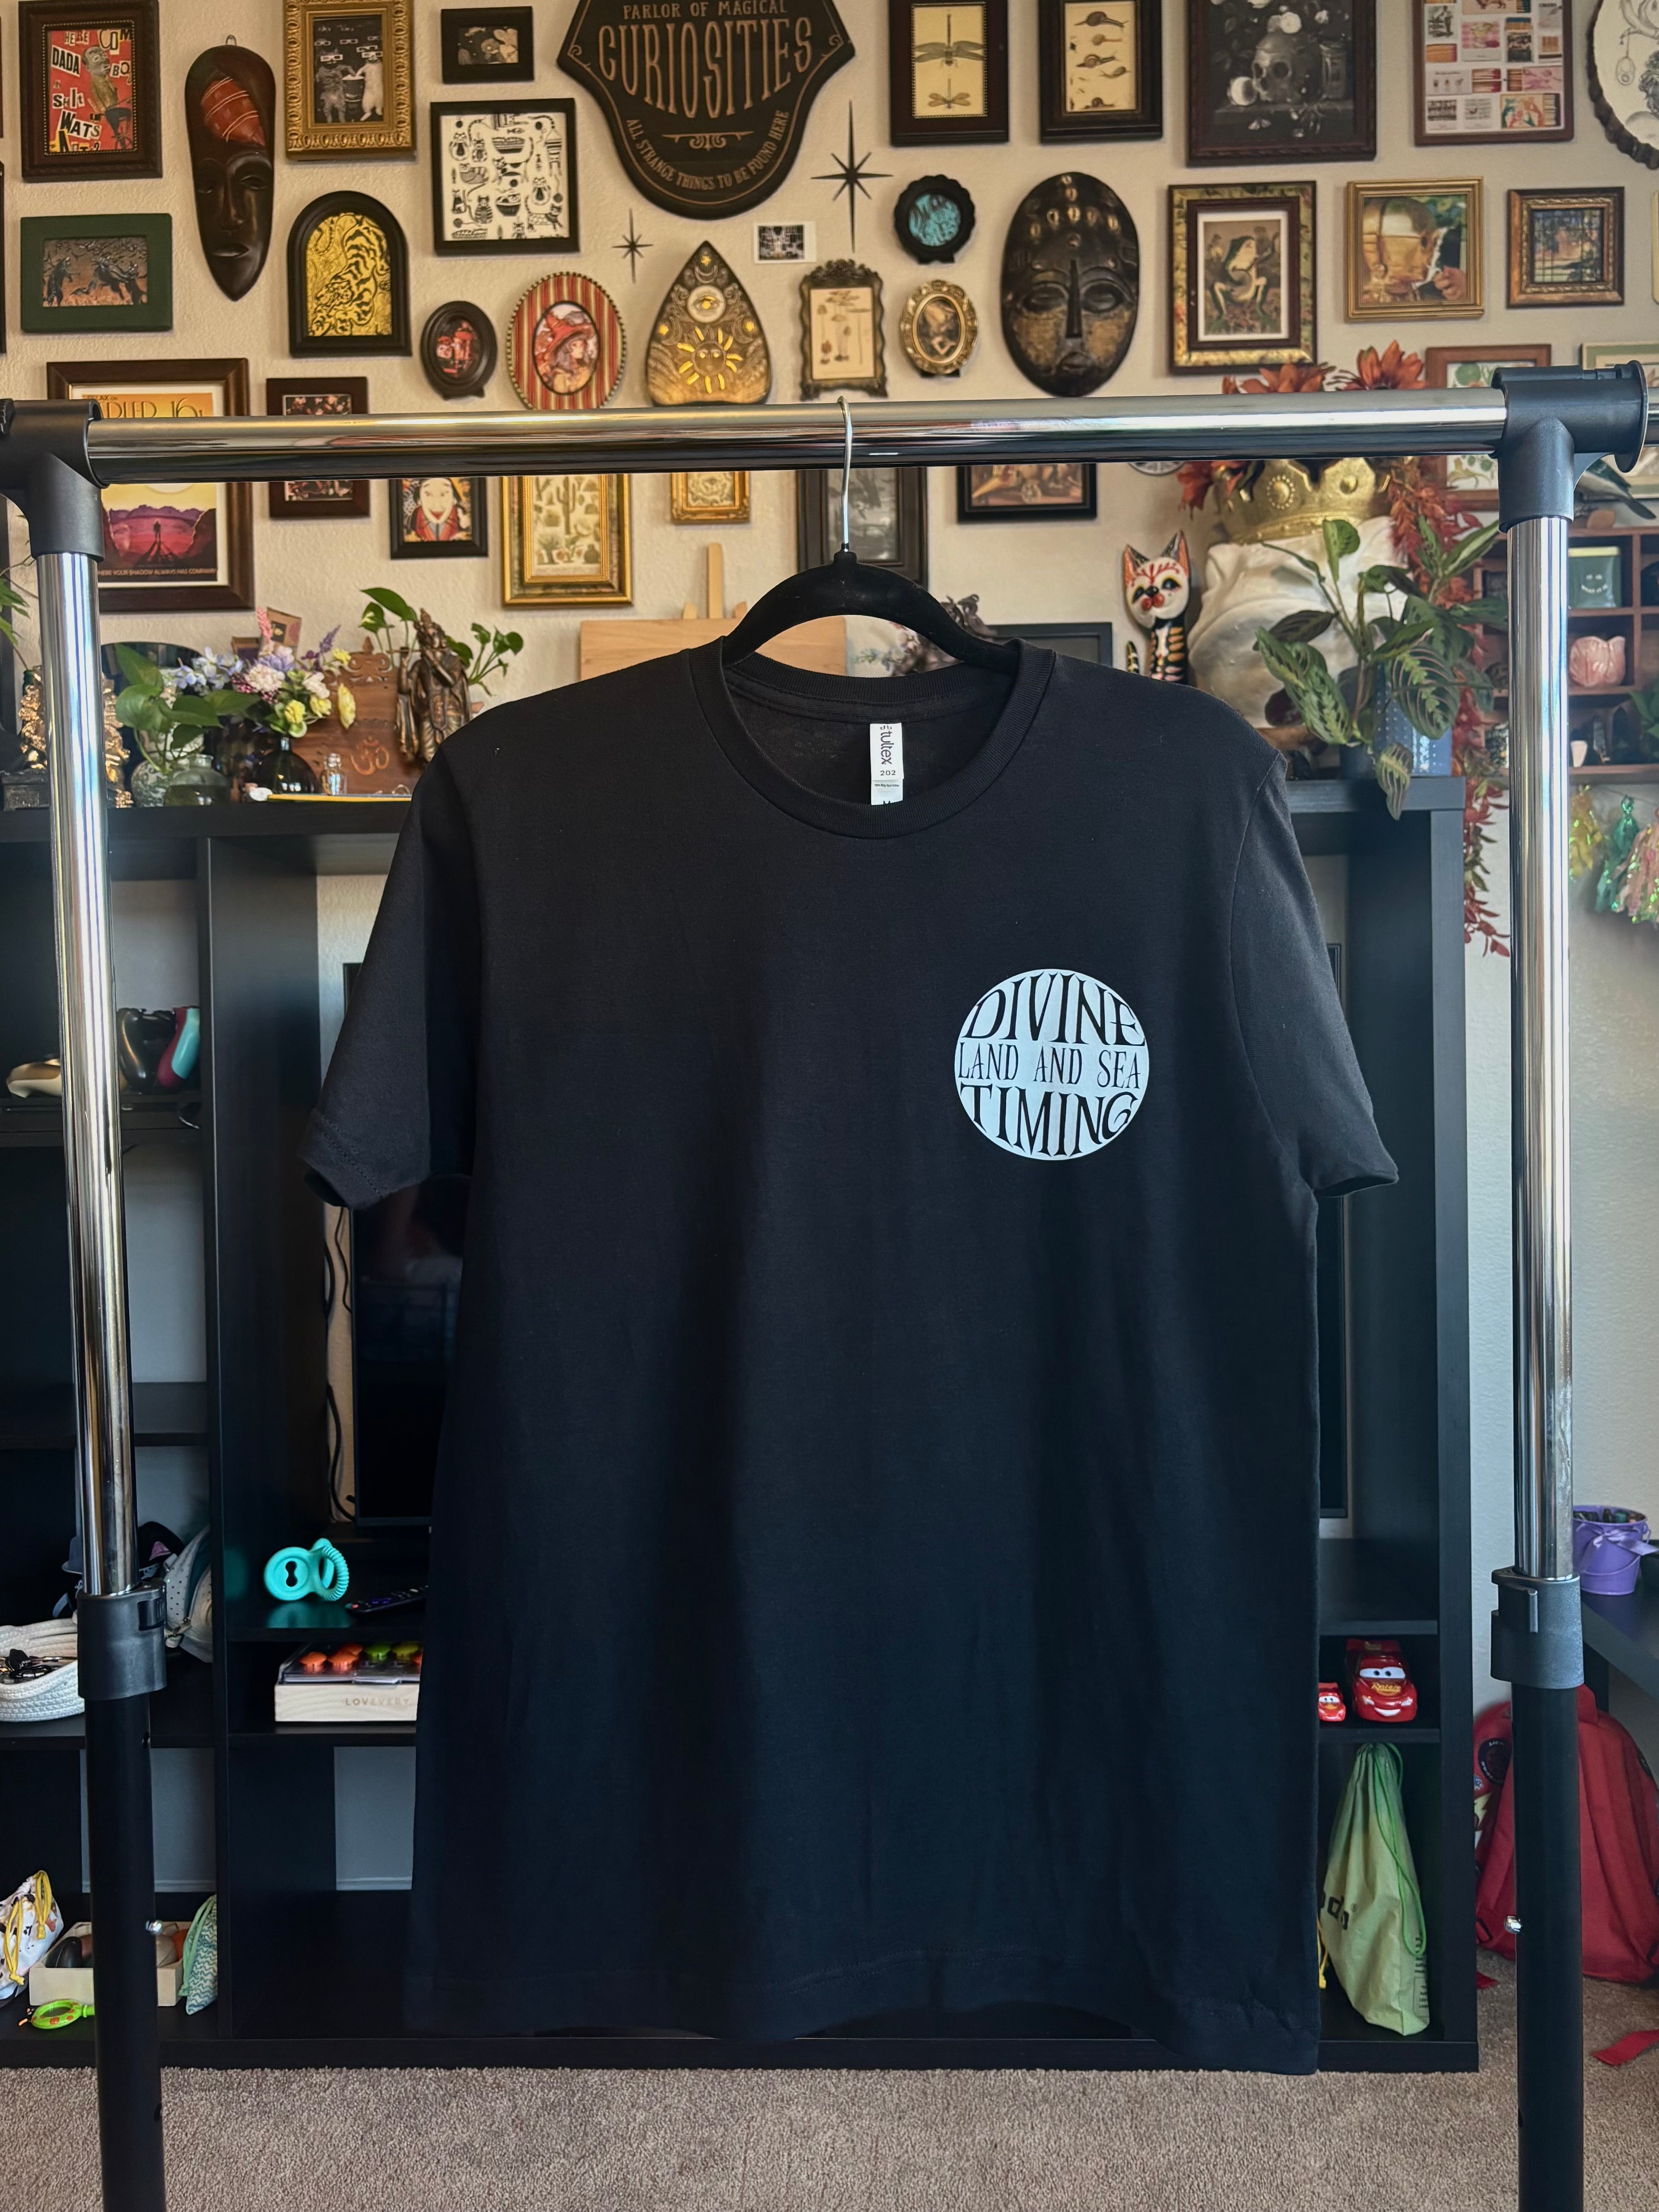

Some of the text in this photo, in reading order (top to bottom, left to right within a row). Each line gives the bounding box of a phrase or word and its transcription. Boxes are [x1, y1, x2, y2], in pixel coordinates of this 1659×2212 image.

[623, 0, 788, 19] PARLOR OF MAGICAL
[52, 48, 80, 75] DADA
[598, 17, 812, 119] CURIOSITIES
[626, 110, 790, 190] ALL STRANGE THINGS TO BE FOUND HERE
[961, 971, 1146, 1047] DIVINE
[958, 1042, 1141, 1090] LAND AND SEA
[960, 1081, 1139, 1157] TIMING
